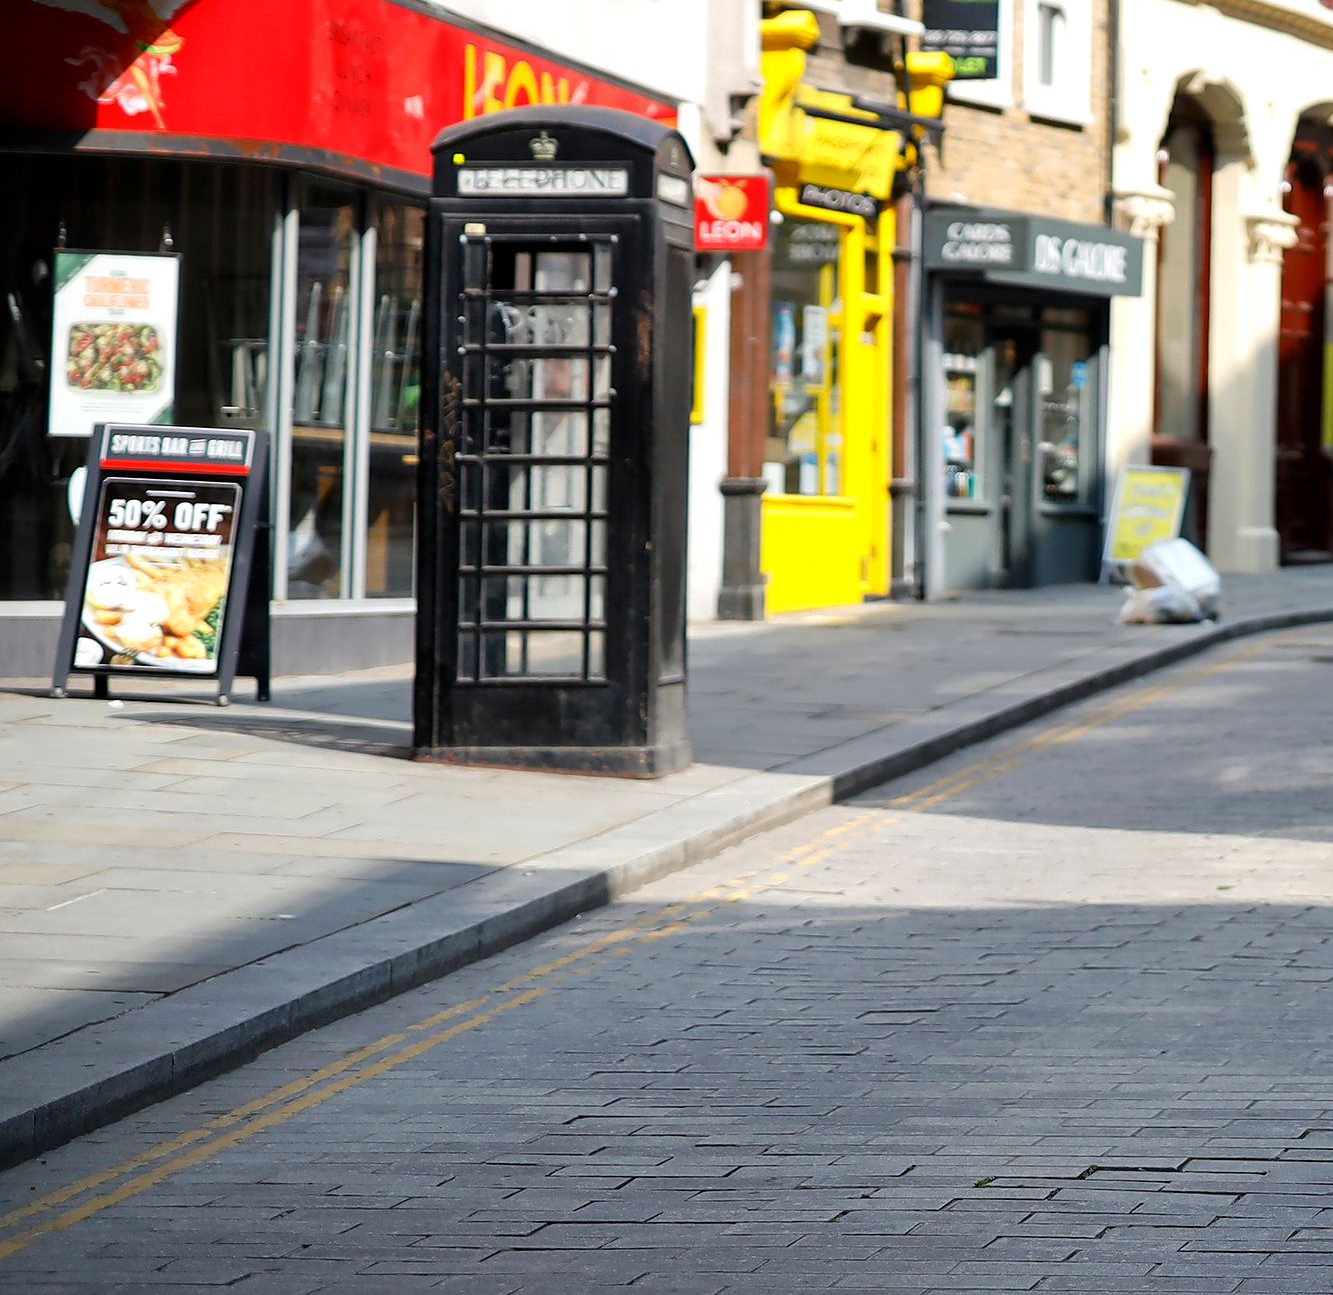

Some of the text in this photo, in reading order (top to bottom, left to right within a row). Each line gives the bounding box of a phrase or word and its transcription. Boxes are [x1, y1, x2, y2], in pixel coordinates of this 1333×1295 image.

[472, 168, 623, 189] TELEPHONE
[803, 185, 877, 217] PHOTOS
[699, 220, 763, 243] LEON
[947, 222, 1011, 241] CARDS
[941, 241, 1013, 262] GALORE
[1063, 239, 1128, 283] GALORE
[111, 435, 161, 455] SPORTS
[162, 437, 189, 456] BAR
[207, 439, 243, 459] GRILL
[108, 499, 167, 529] 50%
